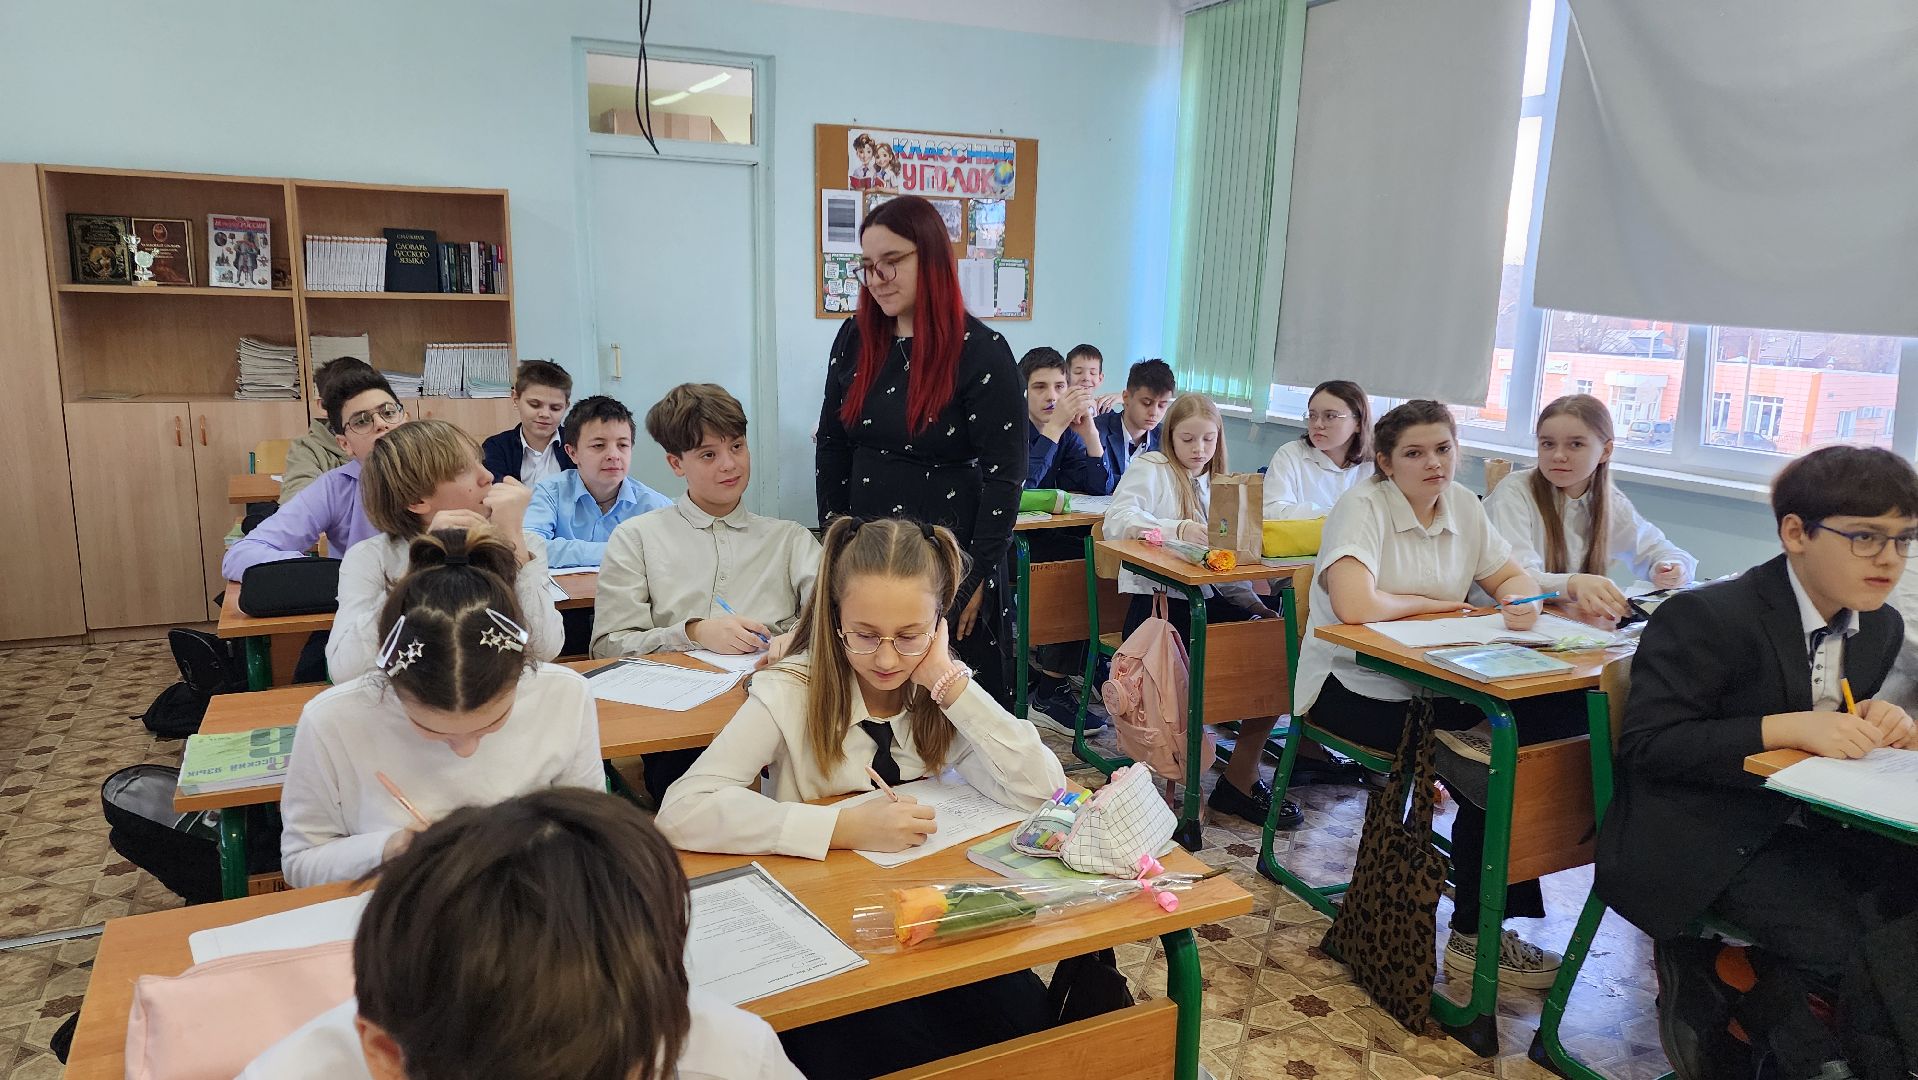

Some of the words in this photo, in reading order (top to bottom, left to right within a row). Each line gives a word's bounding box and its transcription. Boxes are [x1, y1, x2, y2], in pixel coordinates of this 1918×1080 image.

[892, 137, 1015, 166] КЛАССНЫЙ
[902, 162, 997, 194] УГОЛОК
[395, 242, 428, 251] СЛОВАРЬ
[393, 249, 430, 259] РУССКОГО
[399, 257, 425, 265] ЯЗЫКА
